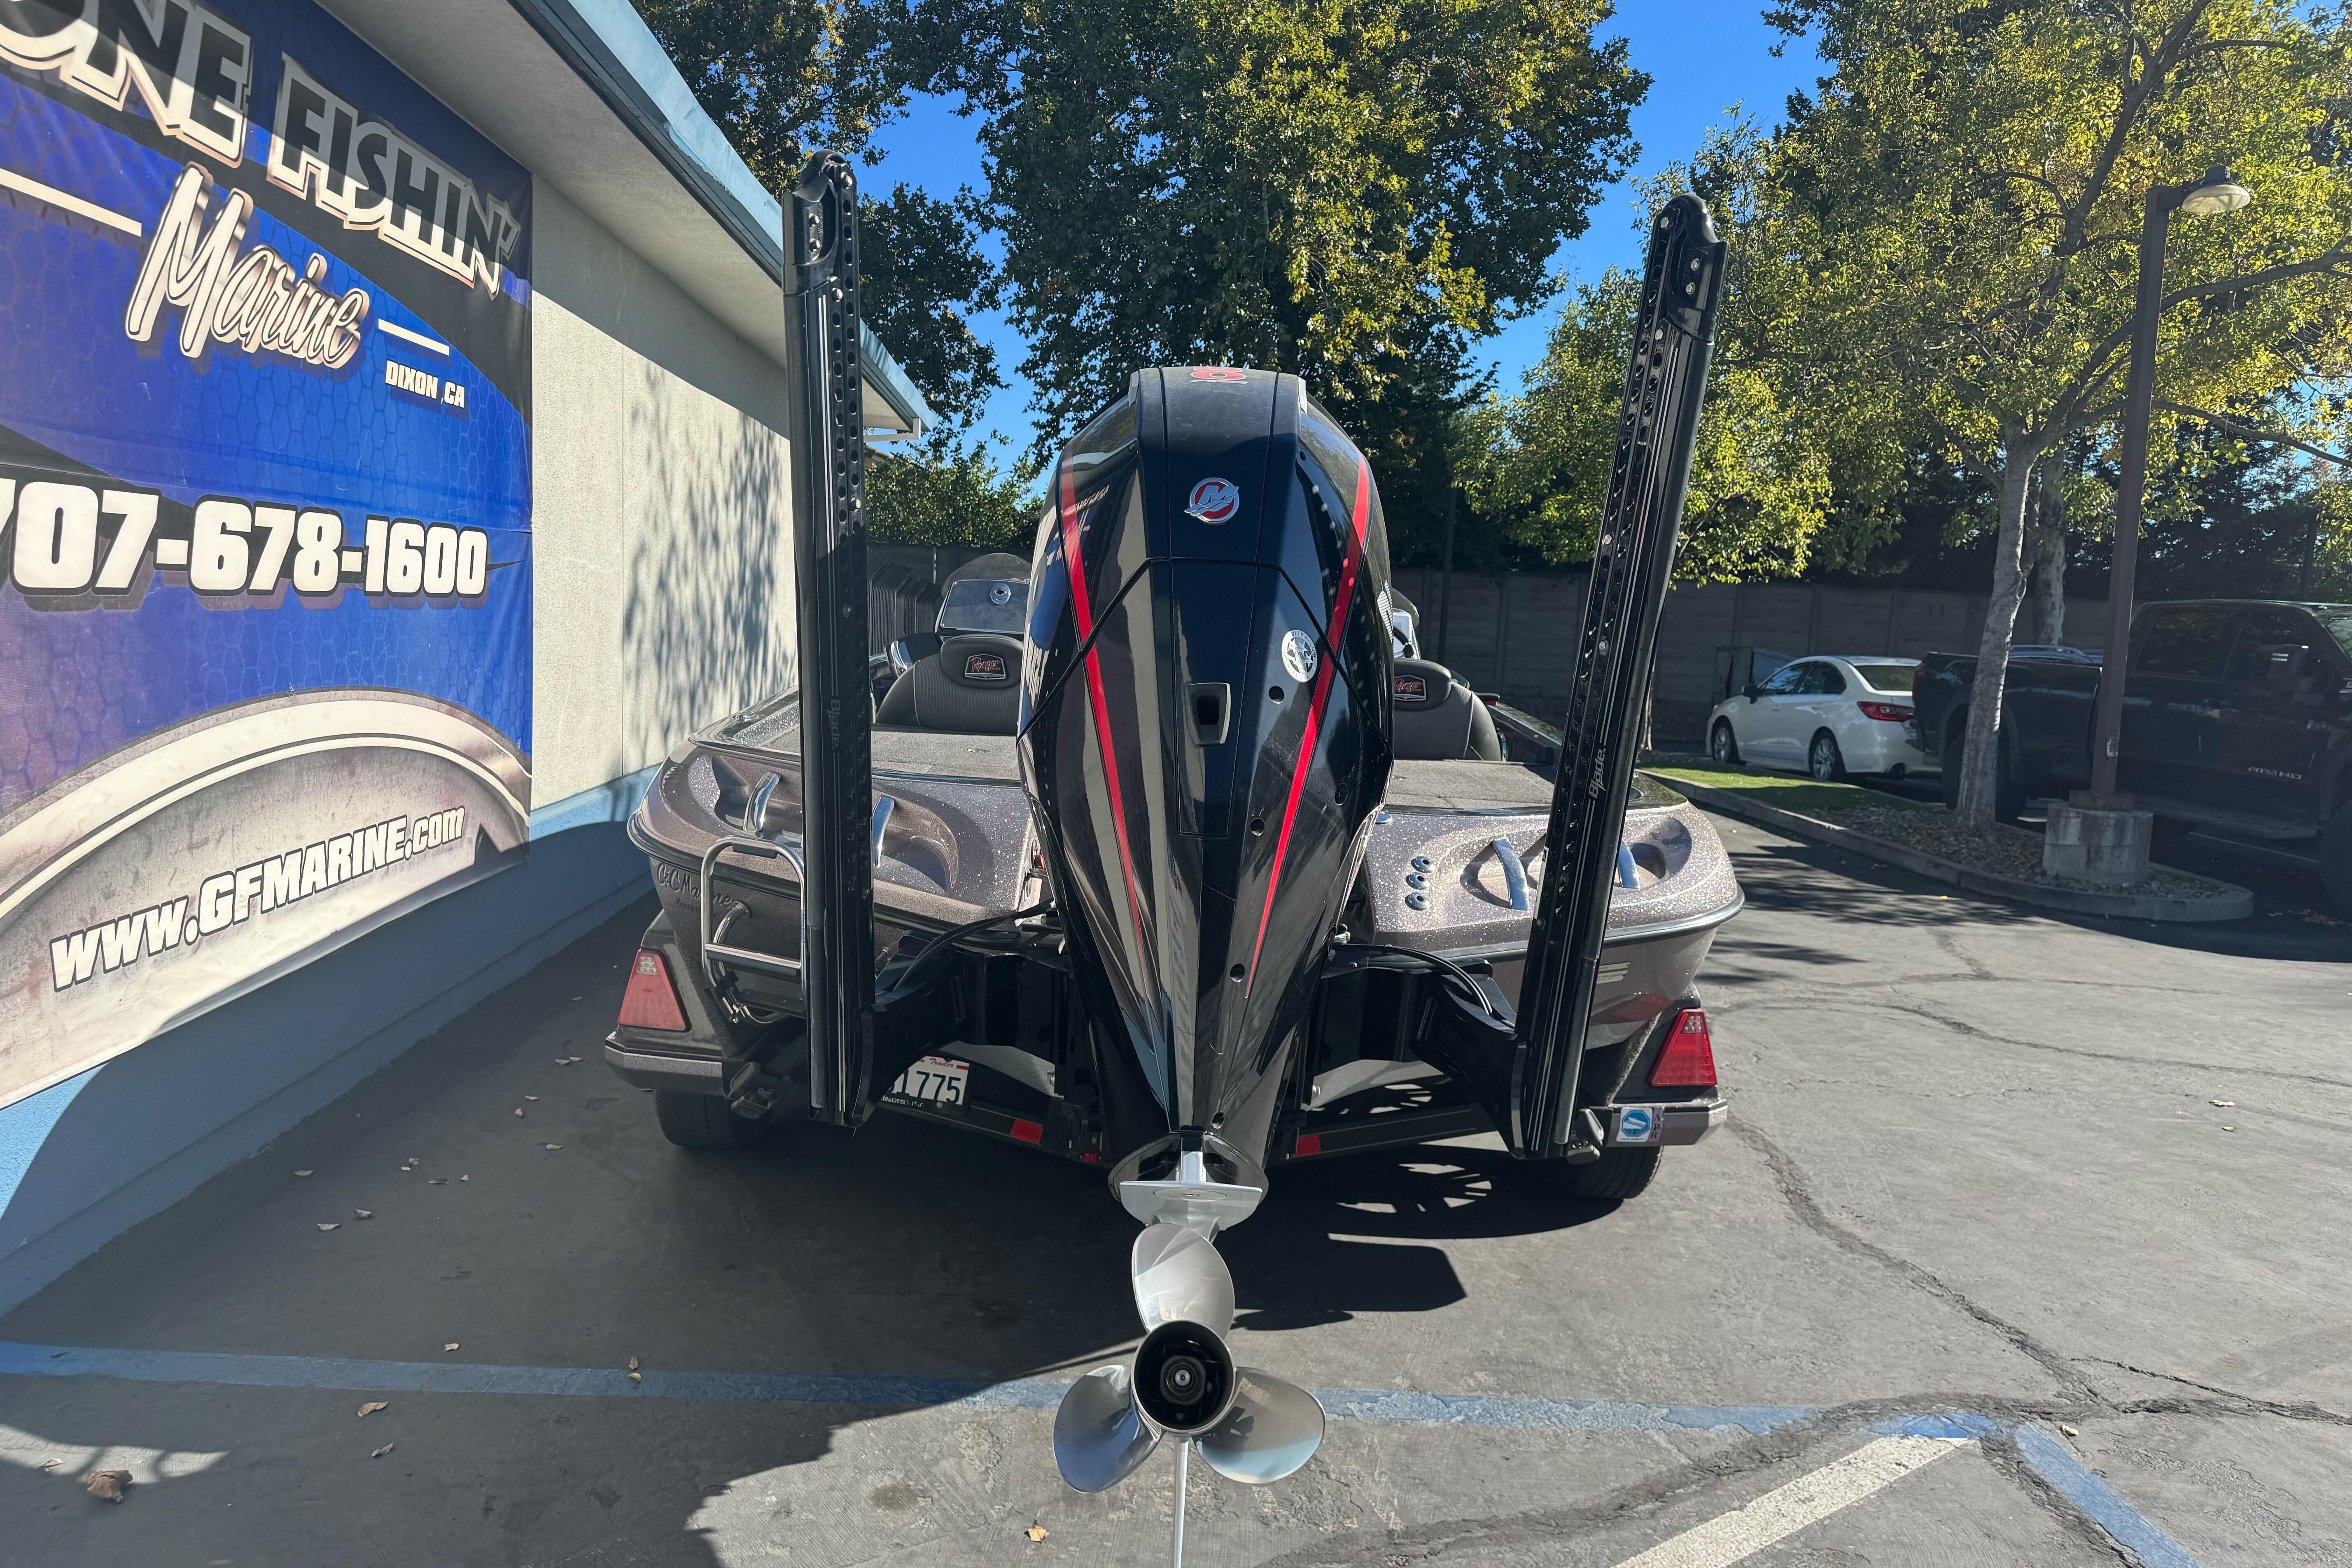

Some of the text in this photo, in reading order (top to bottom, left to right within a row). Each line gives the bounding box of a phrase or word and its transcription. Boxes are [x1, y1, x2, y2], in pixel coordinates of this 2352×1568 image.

[126, 161, 370, 369] Marine
[385, 359, 439, 399] DIXON
[929, 1058, 954, 1068] Trailer
[888, 1069, 961, 1104] 1775
